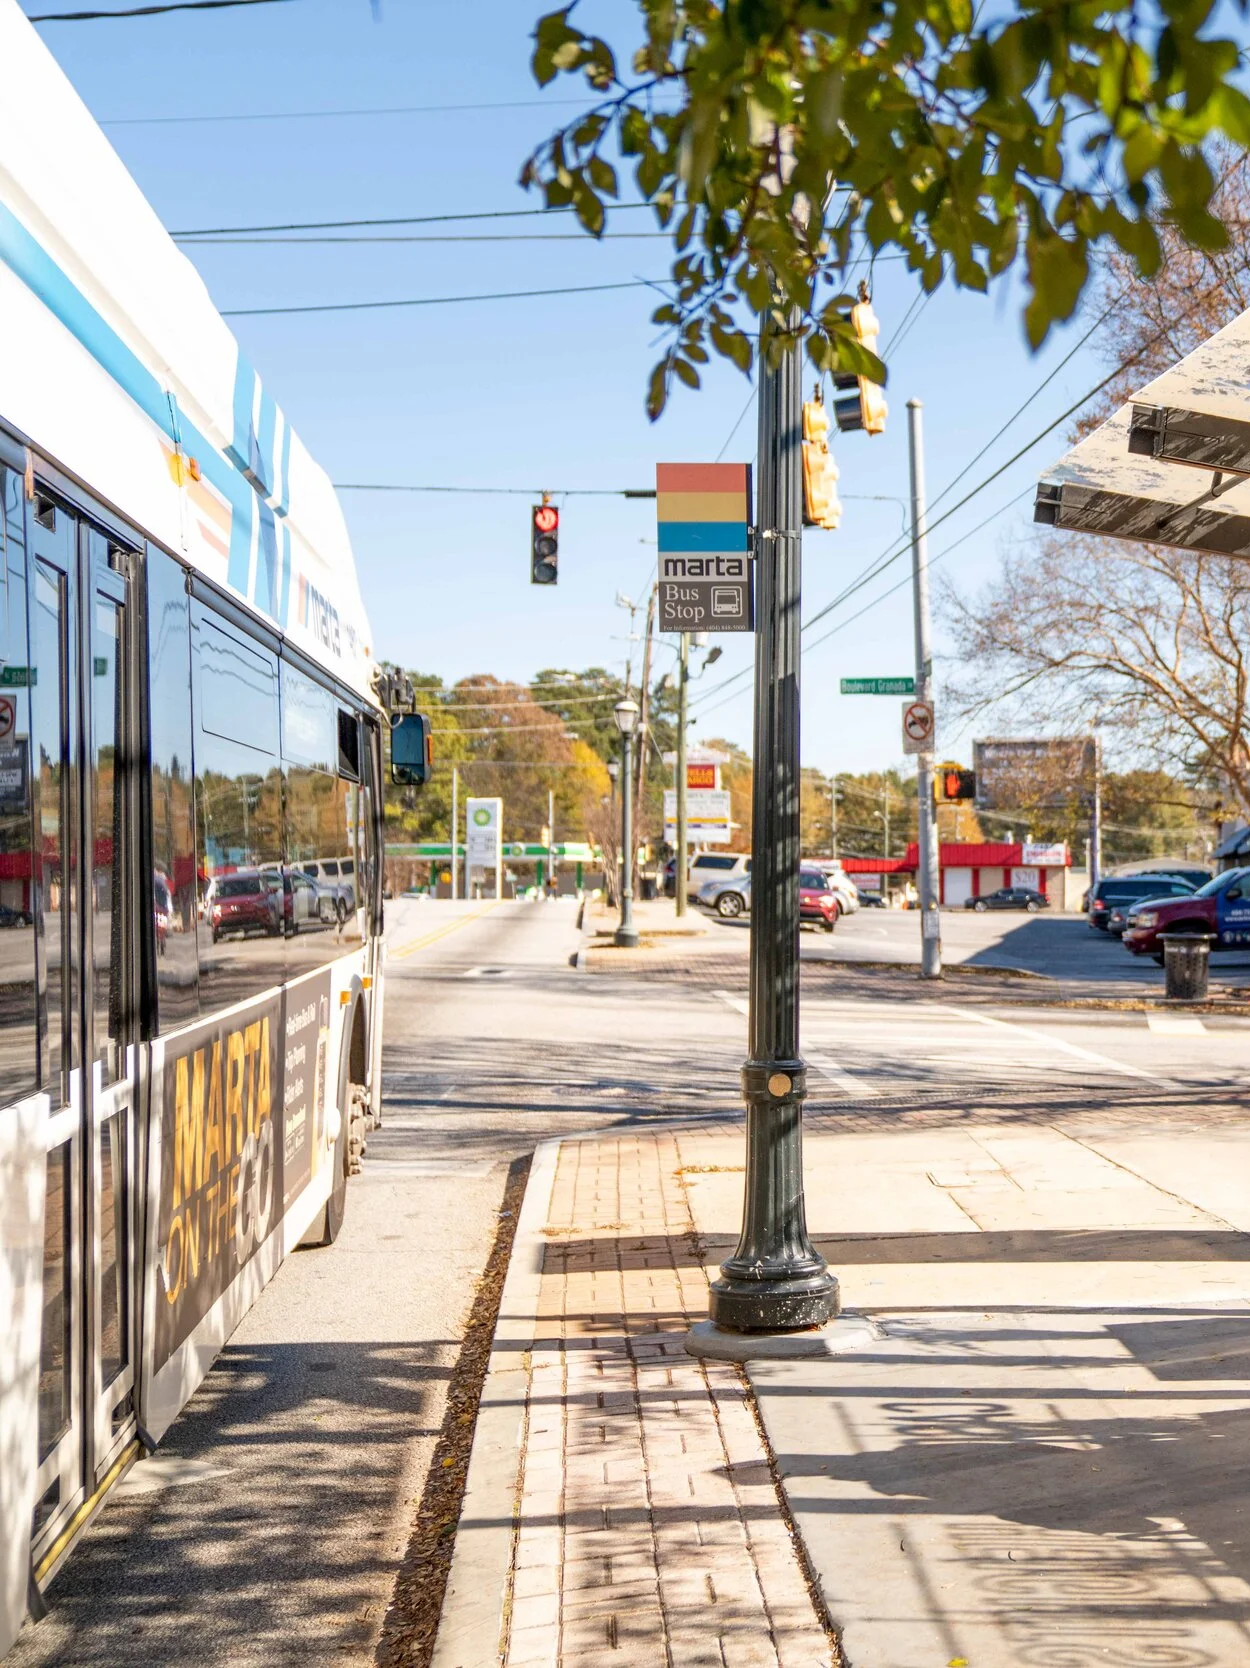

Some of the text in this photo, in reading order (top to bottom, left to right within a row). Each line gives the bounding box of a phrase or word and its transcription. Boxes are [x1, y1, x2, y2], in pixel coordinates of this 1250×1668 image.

[664, 555, 743, 577] marta
[664, 584, 699, 601] Bus
[664, 602, 705, 623] Stop
[173, 1016, 272, 1211] MARTA
[236, 1118, 273, 1265] GO
[165, 1163, 240, 1304] ON THE
